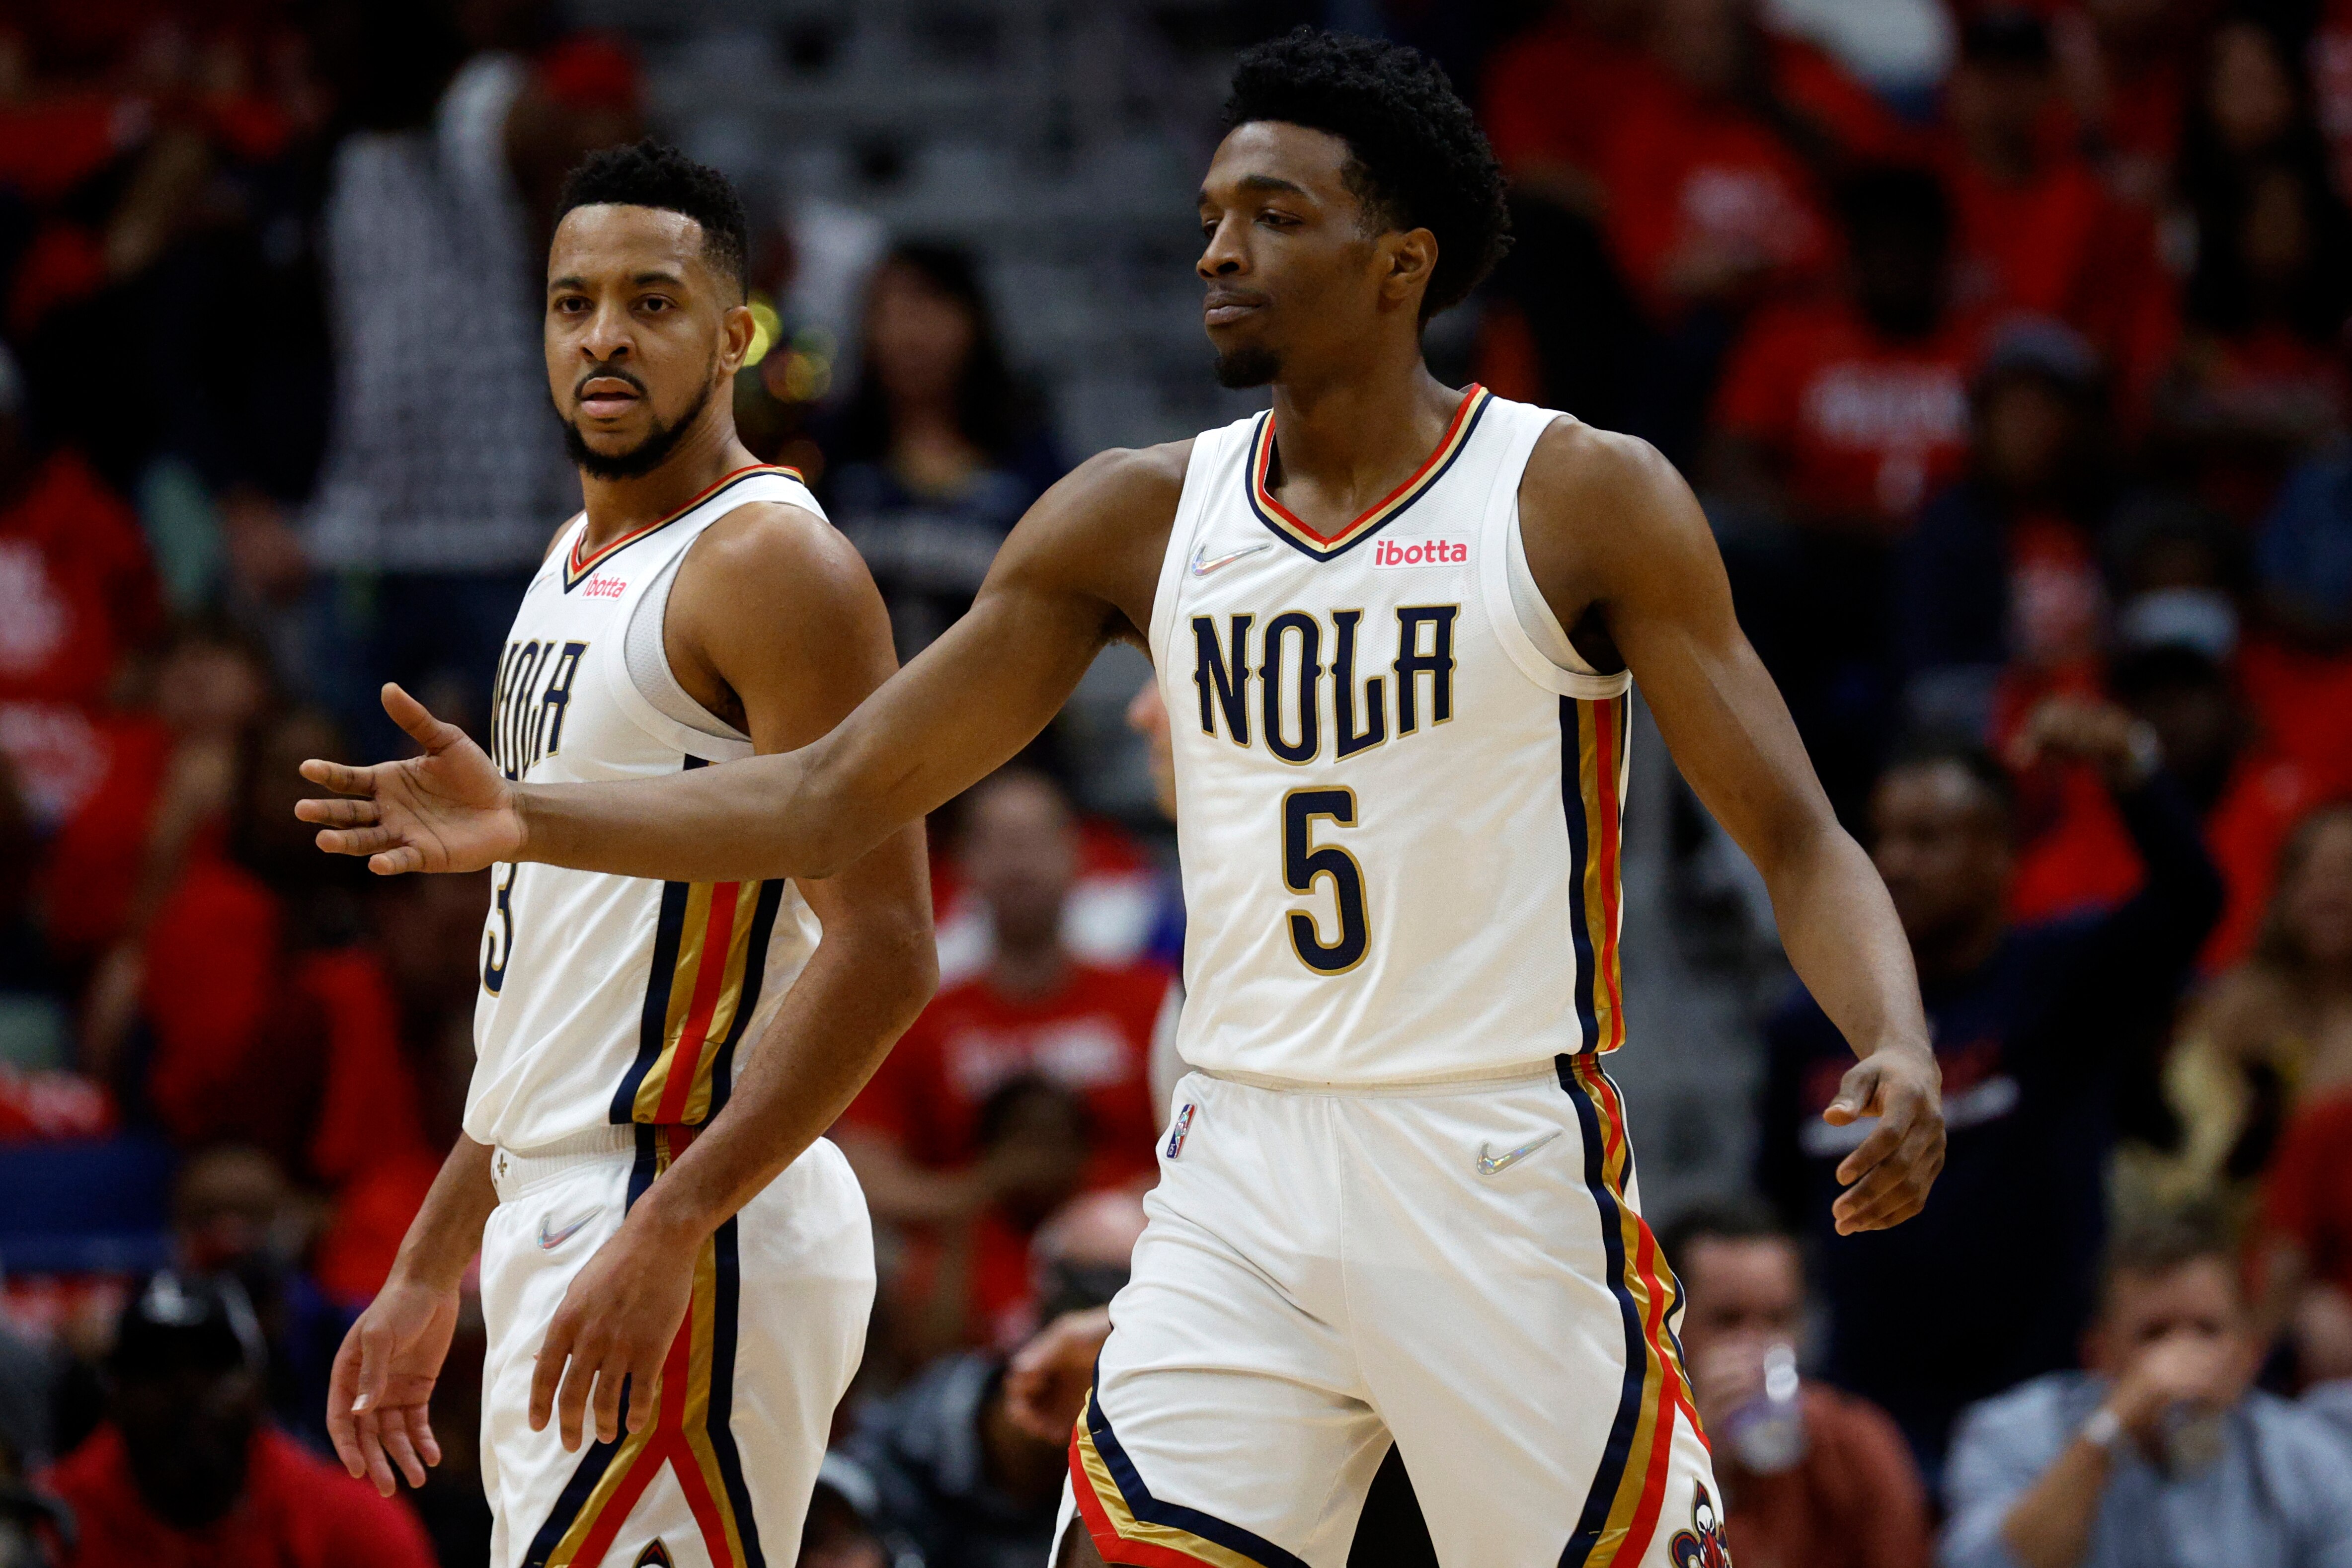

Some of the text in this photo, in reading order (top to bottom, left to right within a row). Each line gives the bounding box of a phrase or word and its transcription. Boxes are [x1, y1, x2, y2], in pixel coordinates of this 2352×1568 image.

[582, 572, 627, 598] ibotta
[1375, 540, 1467, 565] ibotta
[1190, 602, 1461, 766] NOLA
[482, 863, 519, 999] 3
[1281, 785, 1371, 976] 5
